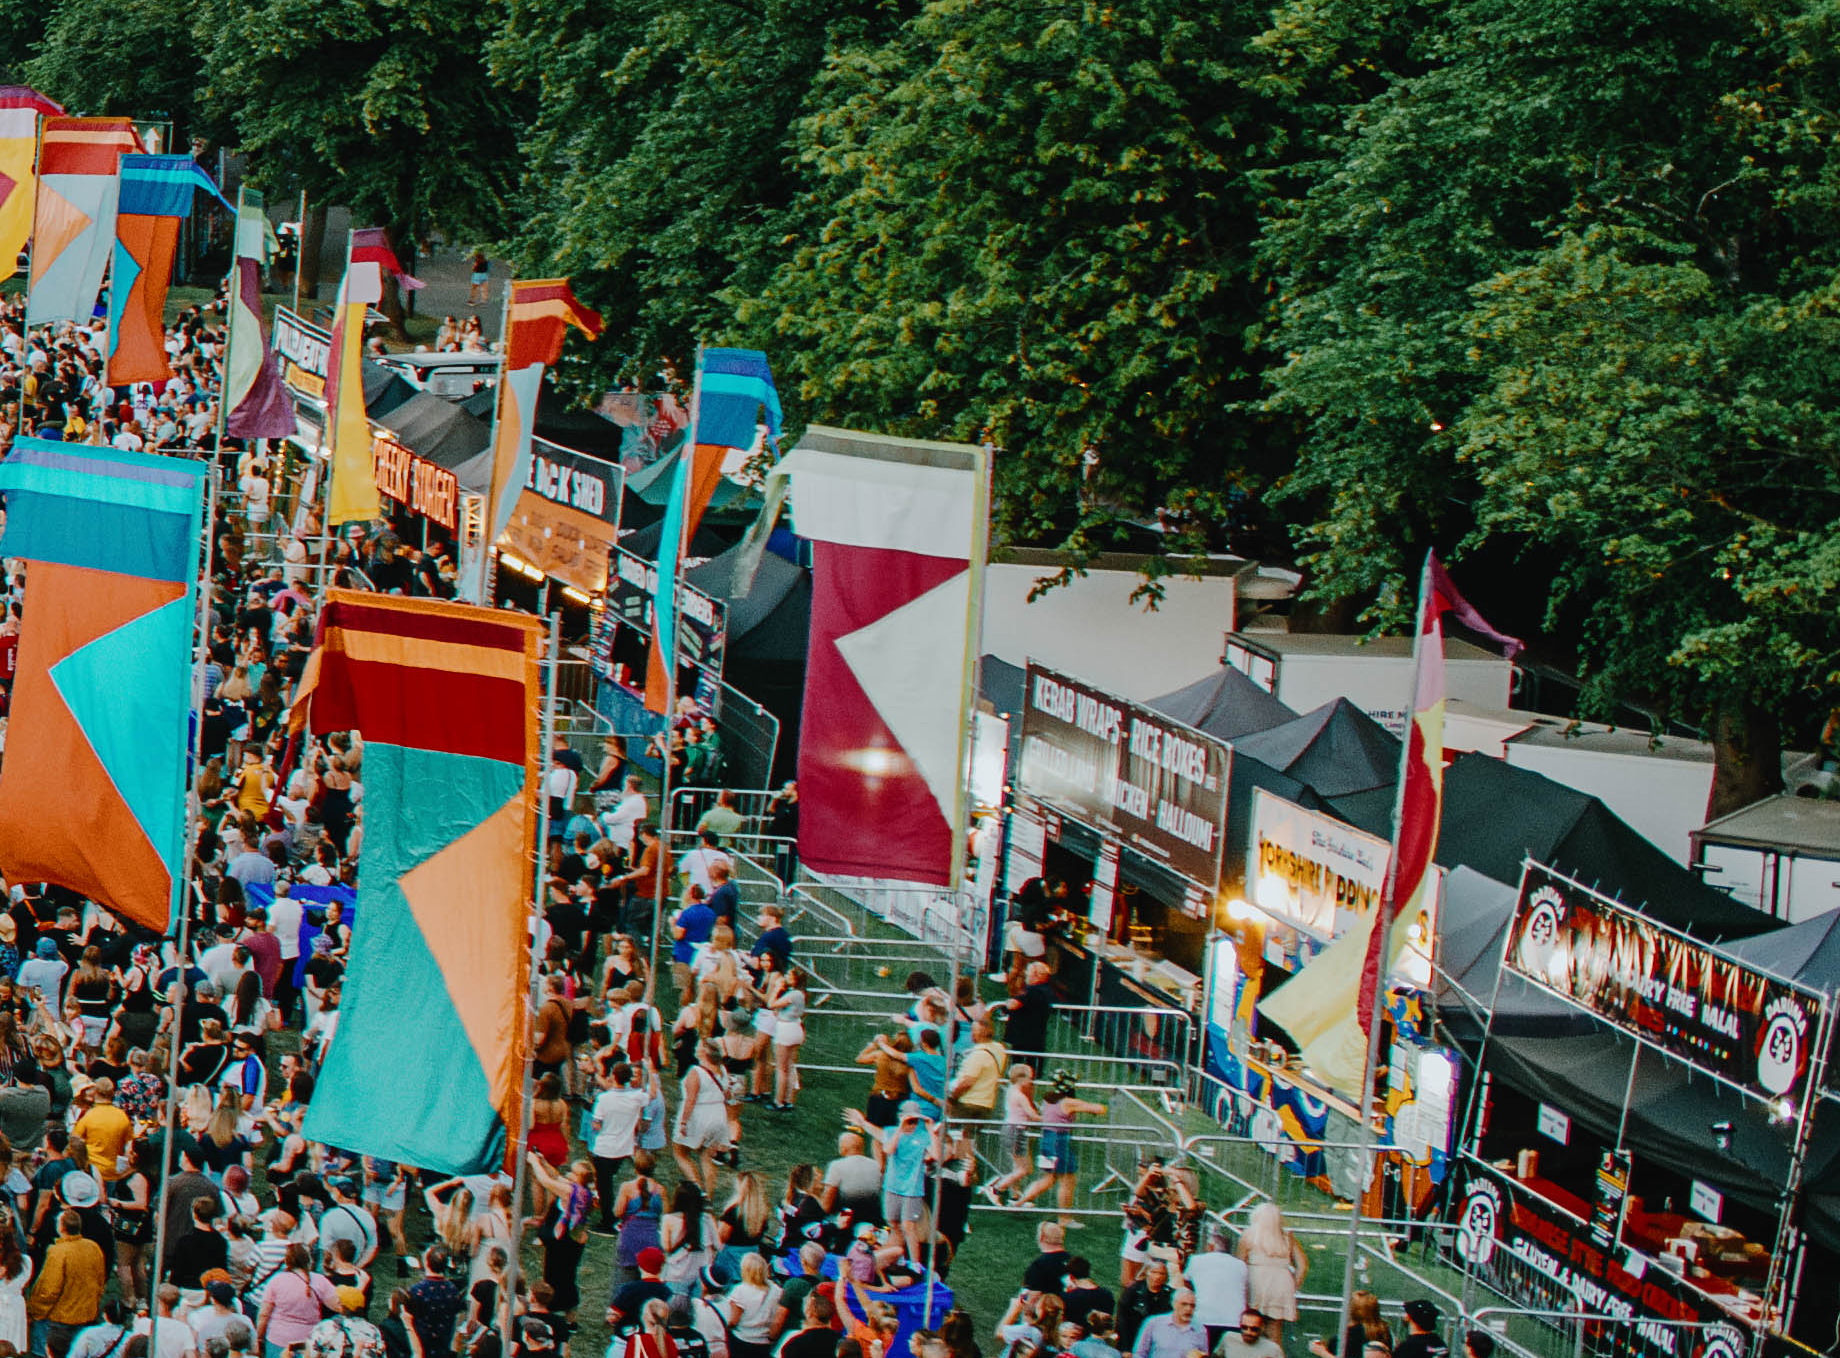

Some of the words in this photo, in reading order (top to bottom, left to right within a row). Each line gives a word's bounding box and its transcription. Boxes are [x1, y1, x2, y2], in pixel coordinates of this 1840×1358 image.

[572, 471, 605, 516] SHED
[1034, 674, 1077, 724] KEBAB
[1077, 692, 1123, 745] WRAPS
[1130, 716, 1163, 767] RICE
[1162, 731, 1208, 786] BOXES
[1156, 798, 1215, 854] HALLOUMI
[1765, 995, 1809, 1039] DARUMA
[1512, 1236, 1561, 1278] GLUTEN
[1571, 1272, 1607, 1312] DAIRY
[1637, 1316, 1677, 1356] HALAL
